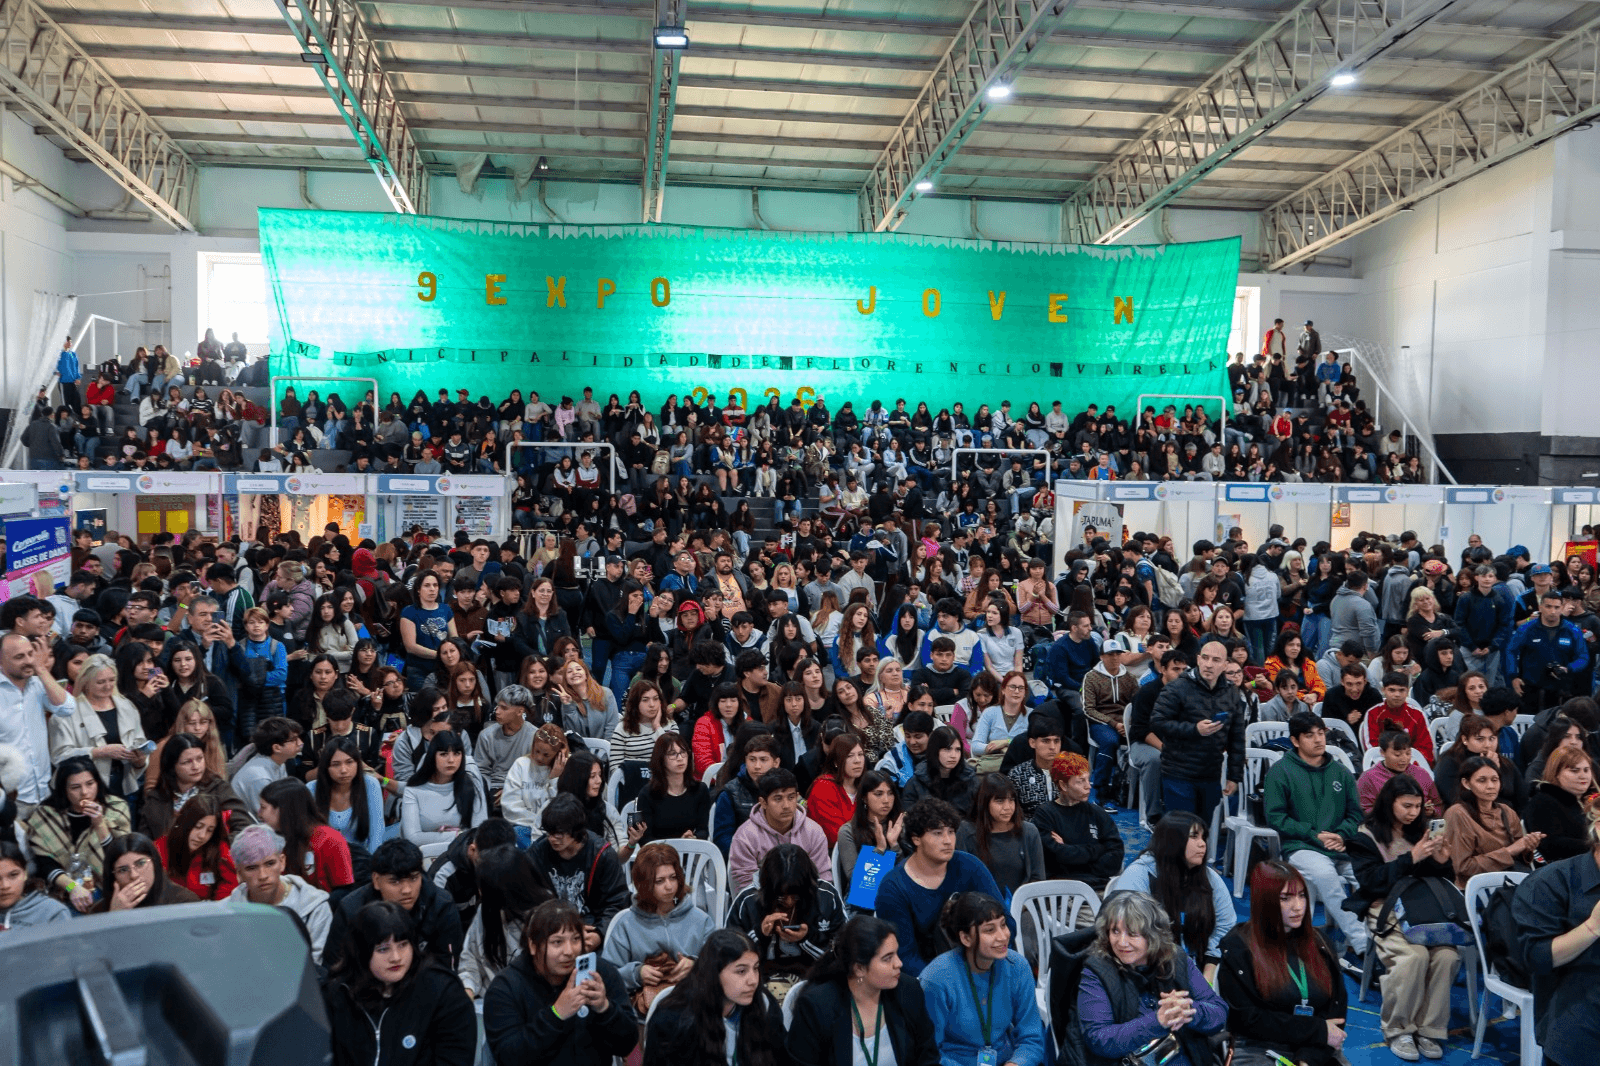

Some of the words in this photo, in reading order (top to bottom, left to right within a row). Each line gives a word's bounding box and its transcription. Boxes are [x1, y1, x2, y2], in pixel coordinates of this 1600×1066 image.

[485, 273, 671, 309] EXPO
[856, 285, 1135, 325] JOVEN
[297, 343, 699, 368] MUNICIPALIDAD
[731, 356, 769, 368] DE
[806, 357, 1041, 374] FLORENCIO
[1076, 360, 1217, 375] VARELA
[13, 555, 38, 569] CLASES
[39, 551, 48, 562] DE
